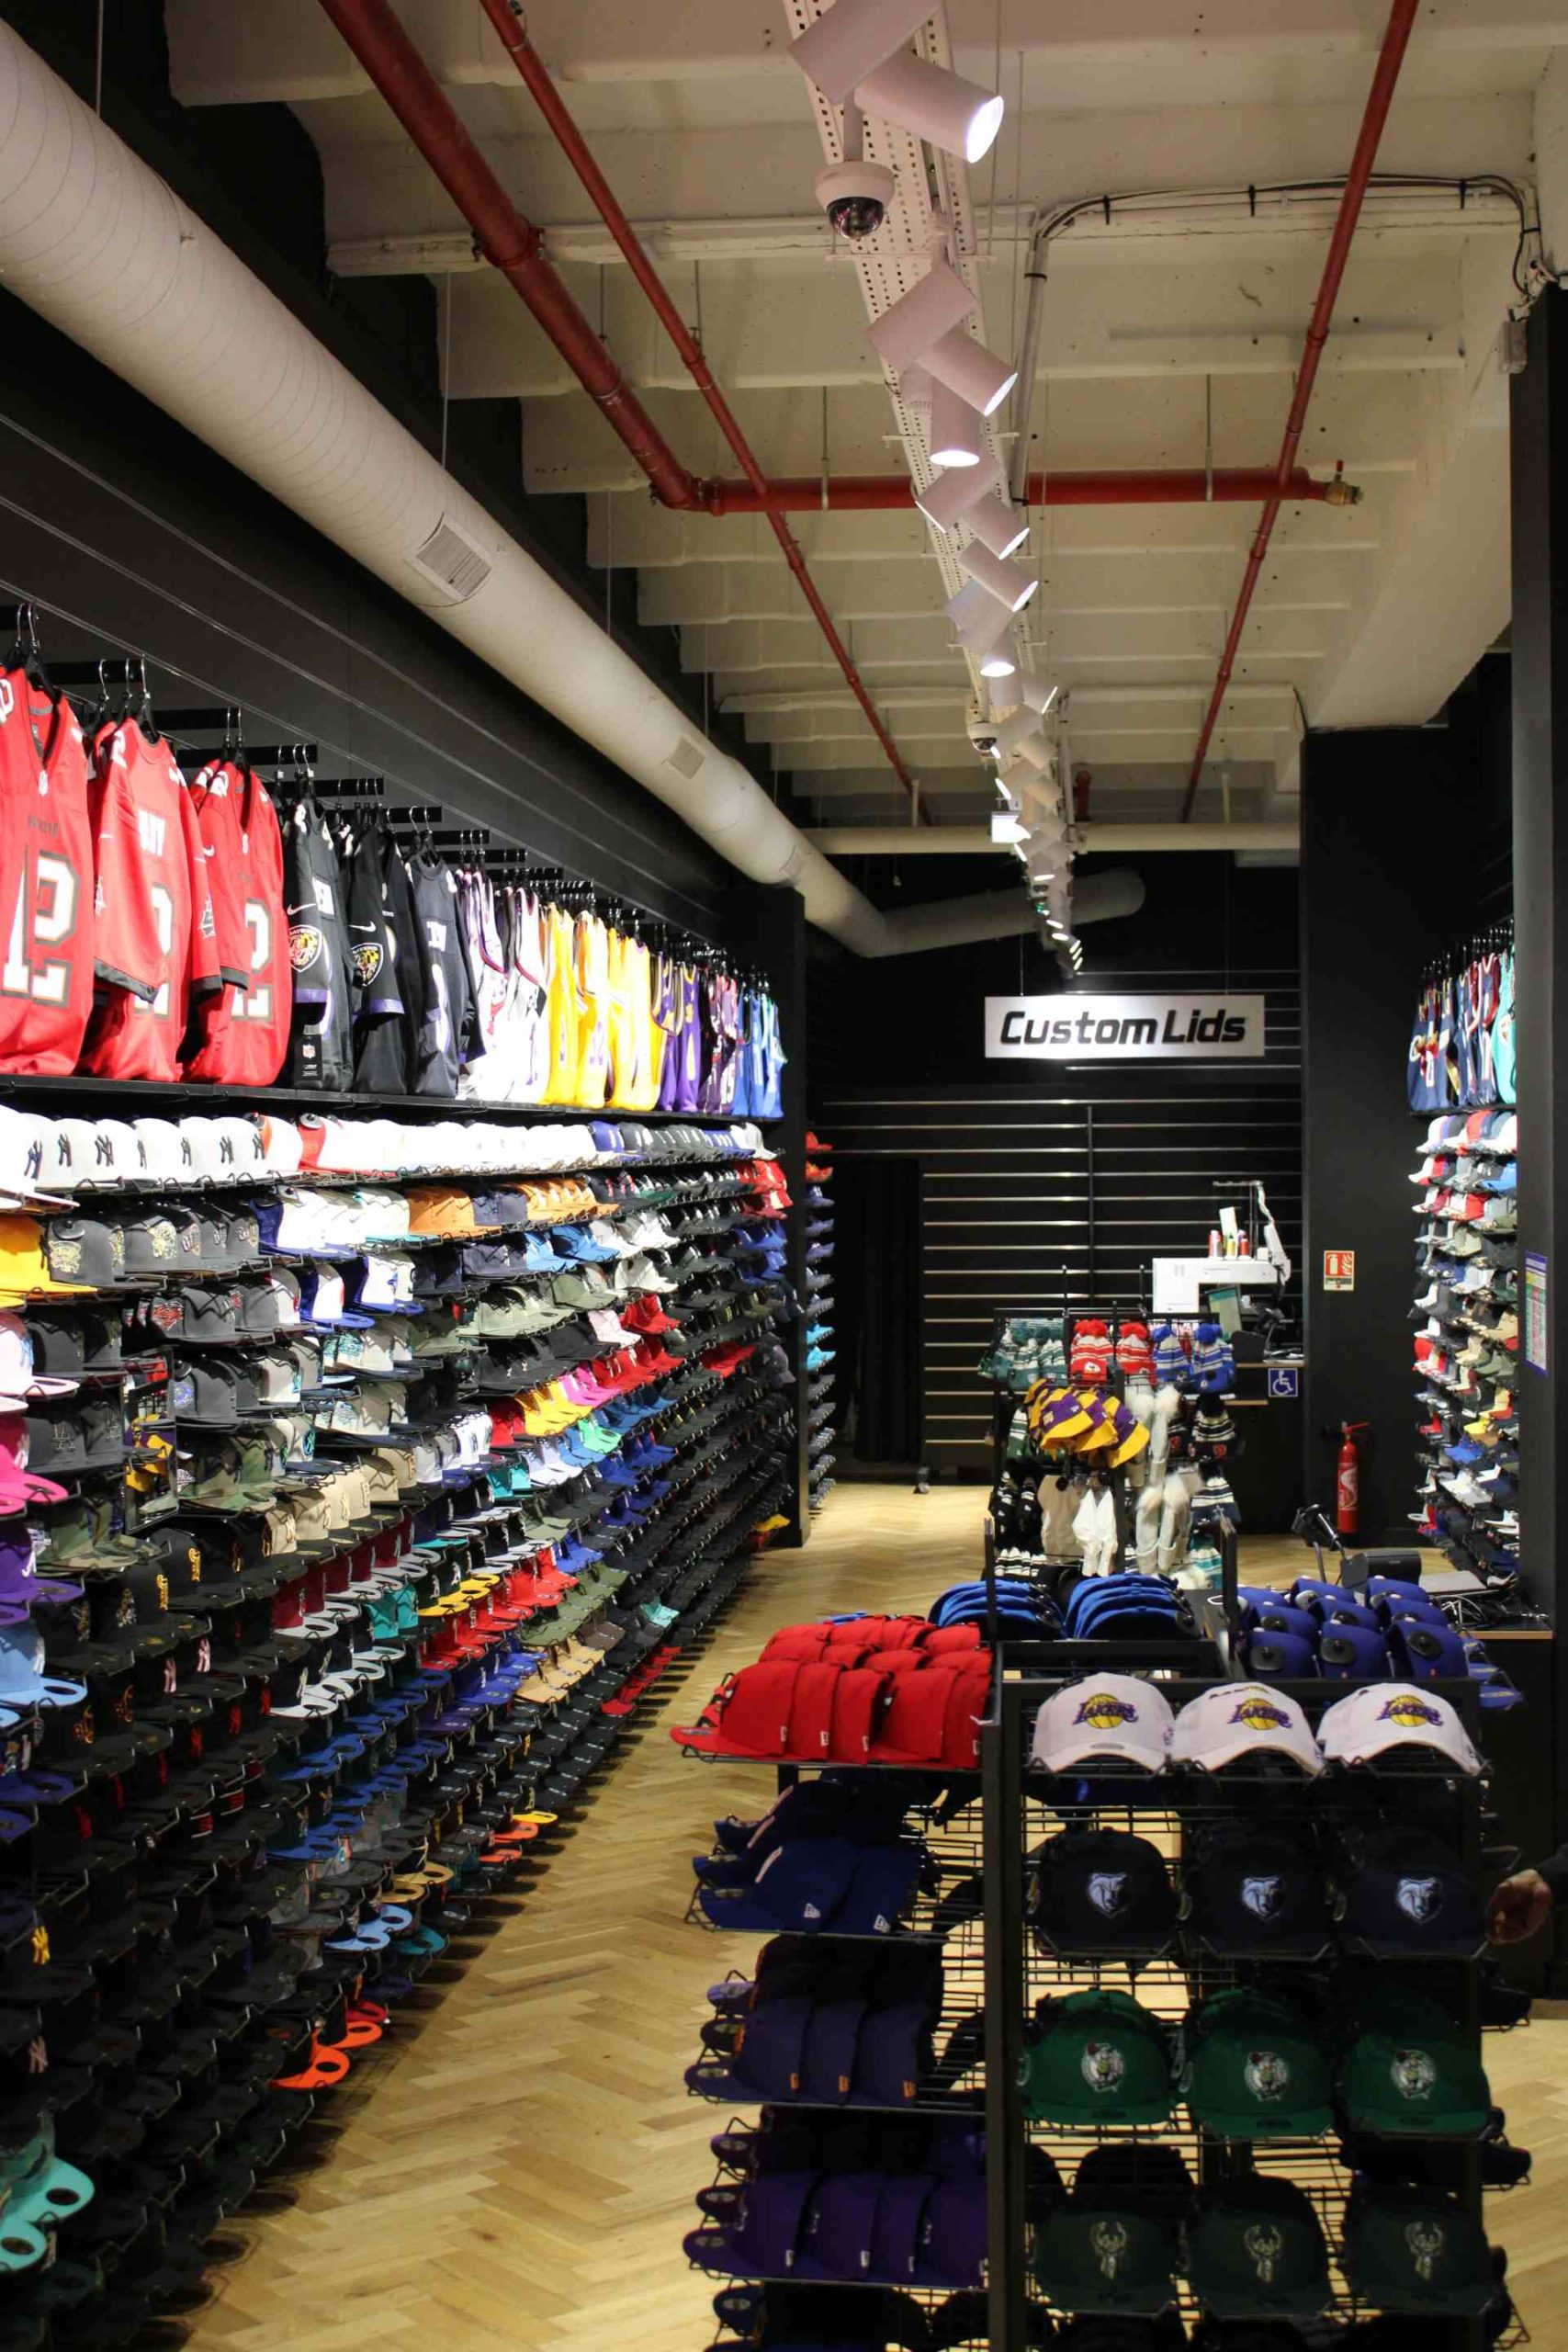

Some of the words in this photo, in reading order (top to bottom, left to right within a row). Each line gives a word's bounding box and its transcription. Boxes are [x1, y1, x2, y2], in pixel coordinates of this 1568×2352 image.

[1000, 1011, 1157, 1046] Custom
[1162, 1009, 1246, 1044] Lids
[1072, 1701, 1139, 1724] LAKERS
[1227, 1703, 1292, 1728] LAKERS
[1376, 1700, 1444, 1726] LAKERS
